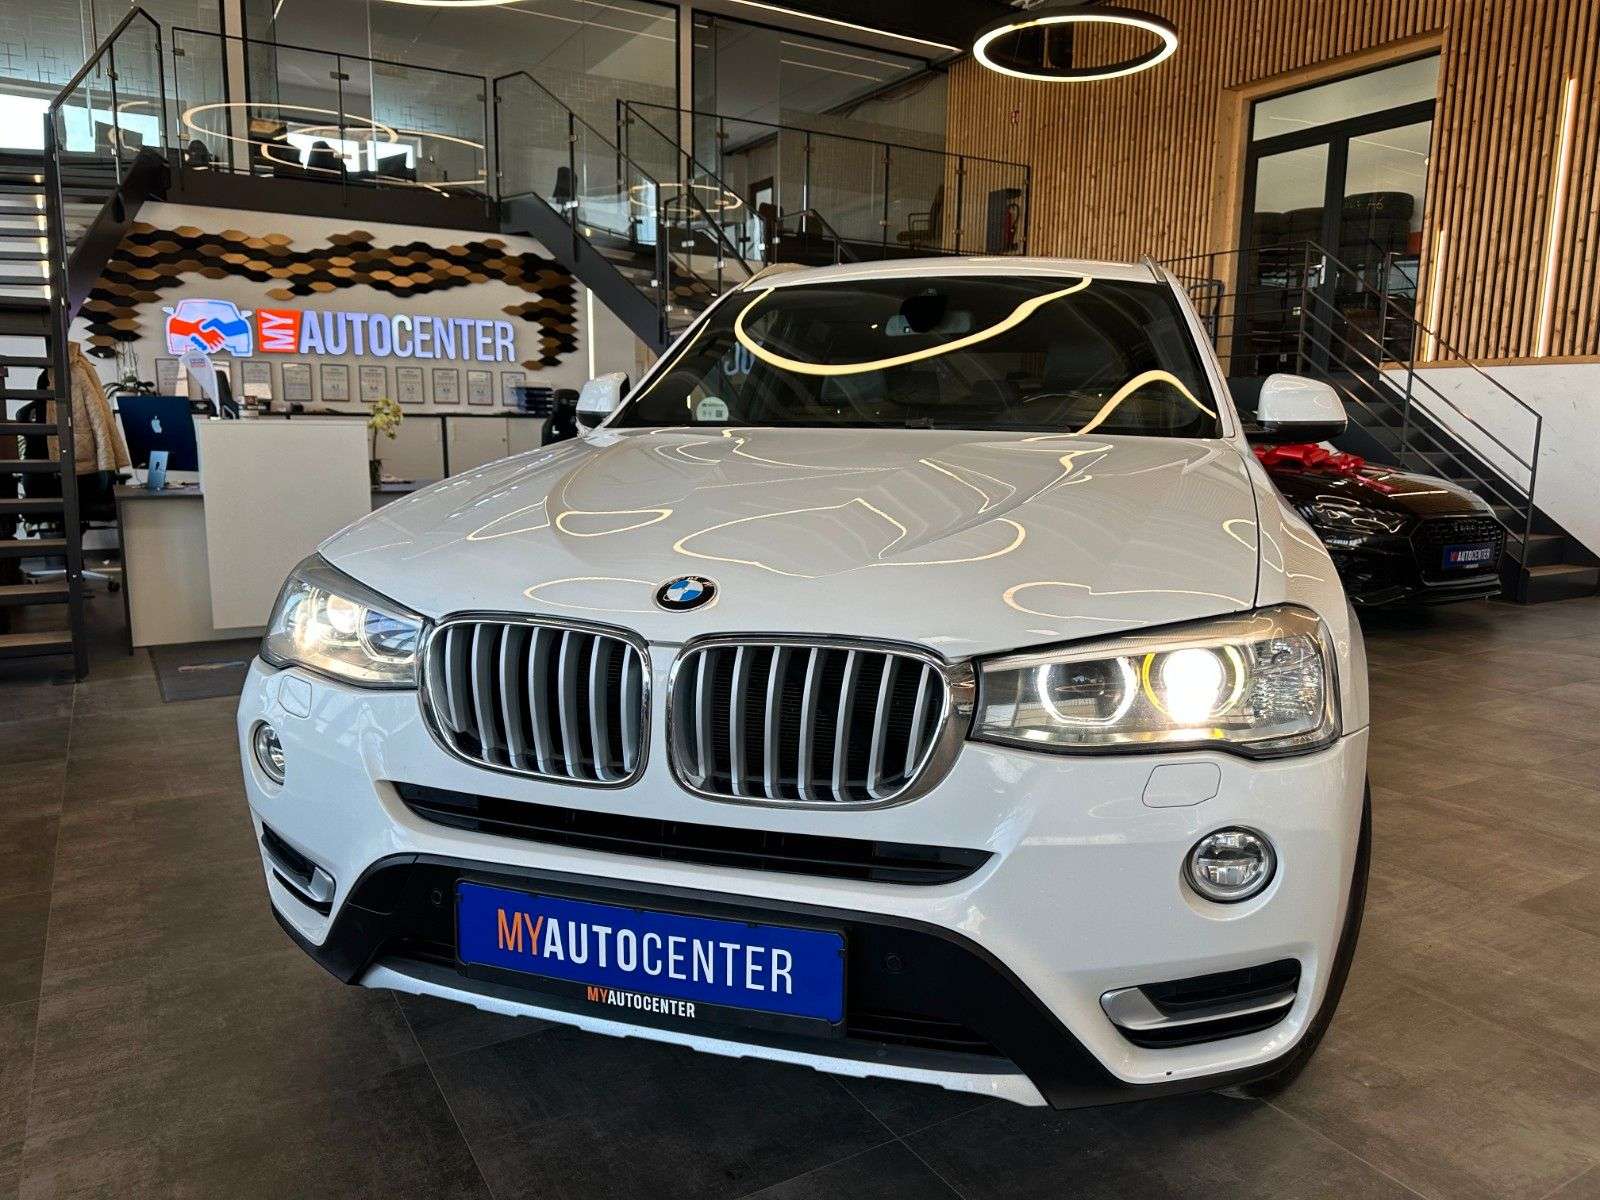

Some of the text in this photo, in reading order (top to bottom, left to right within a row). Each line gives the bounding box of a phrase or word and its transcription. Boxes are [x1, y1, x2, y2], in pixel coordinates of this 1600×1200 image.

[260, 310, 515, 362] MY AUTOCENTER
[497, 908, 793, 995] MYAUTOCENTER
[587, 985, 695, 1018] MYAUTOCENTER
